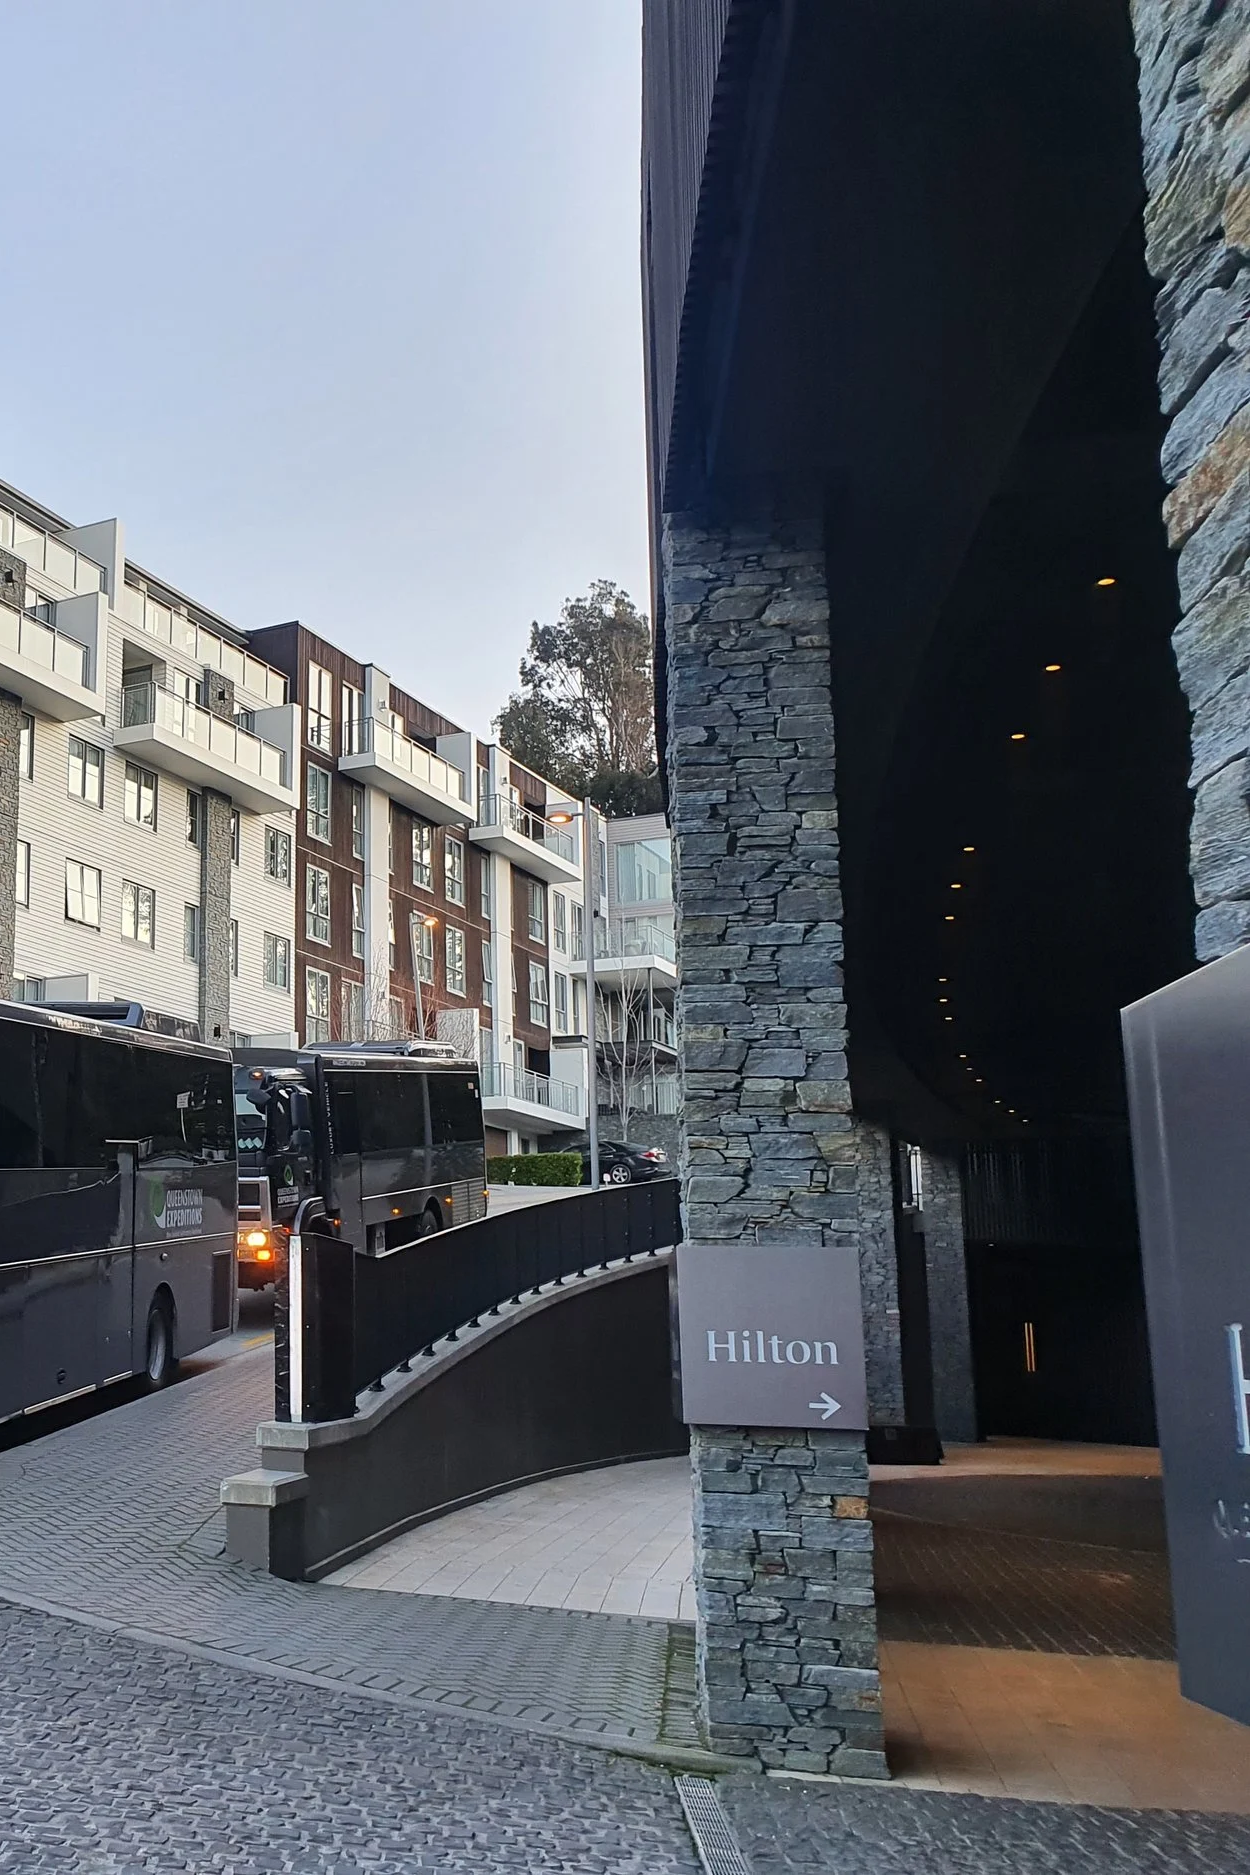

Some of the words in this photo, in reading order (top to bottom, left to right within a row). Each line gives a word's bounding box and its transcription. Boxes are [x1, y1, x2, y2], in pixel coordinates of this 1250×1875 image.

[166, 1189, 203, 1207] QUEENSTOWN
[166, 1208, 203, 1227] EXPEDITIONS
[706, 1330, 839, 1365] Hilton
